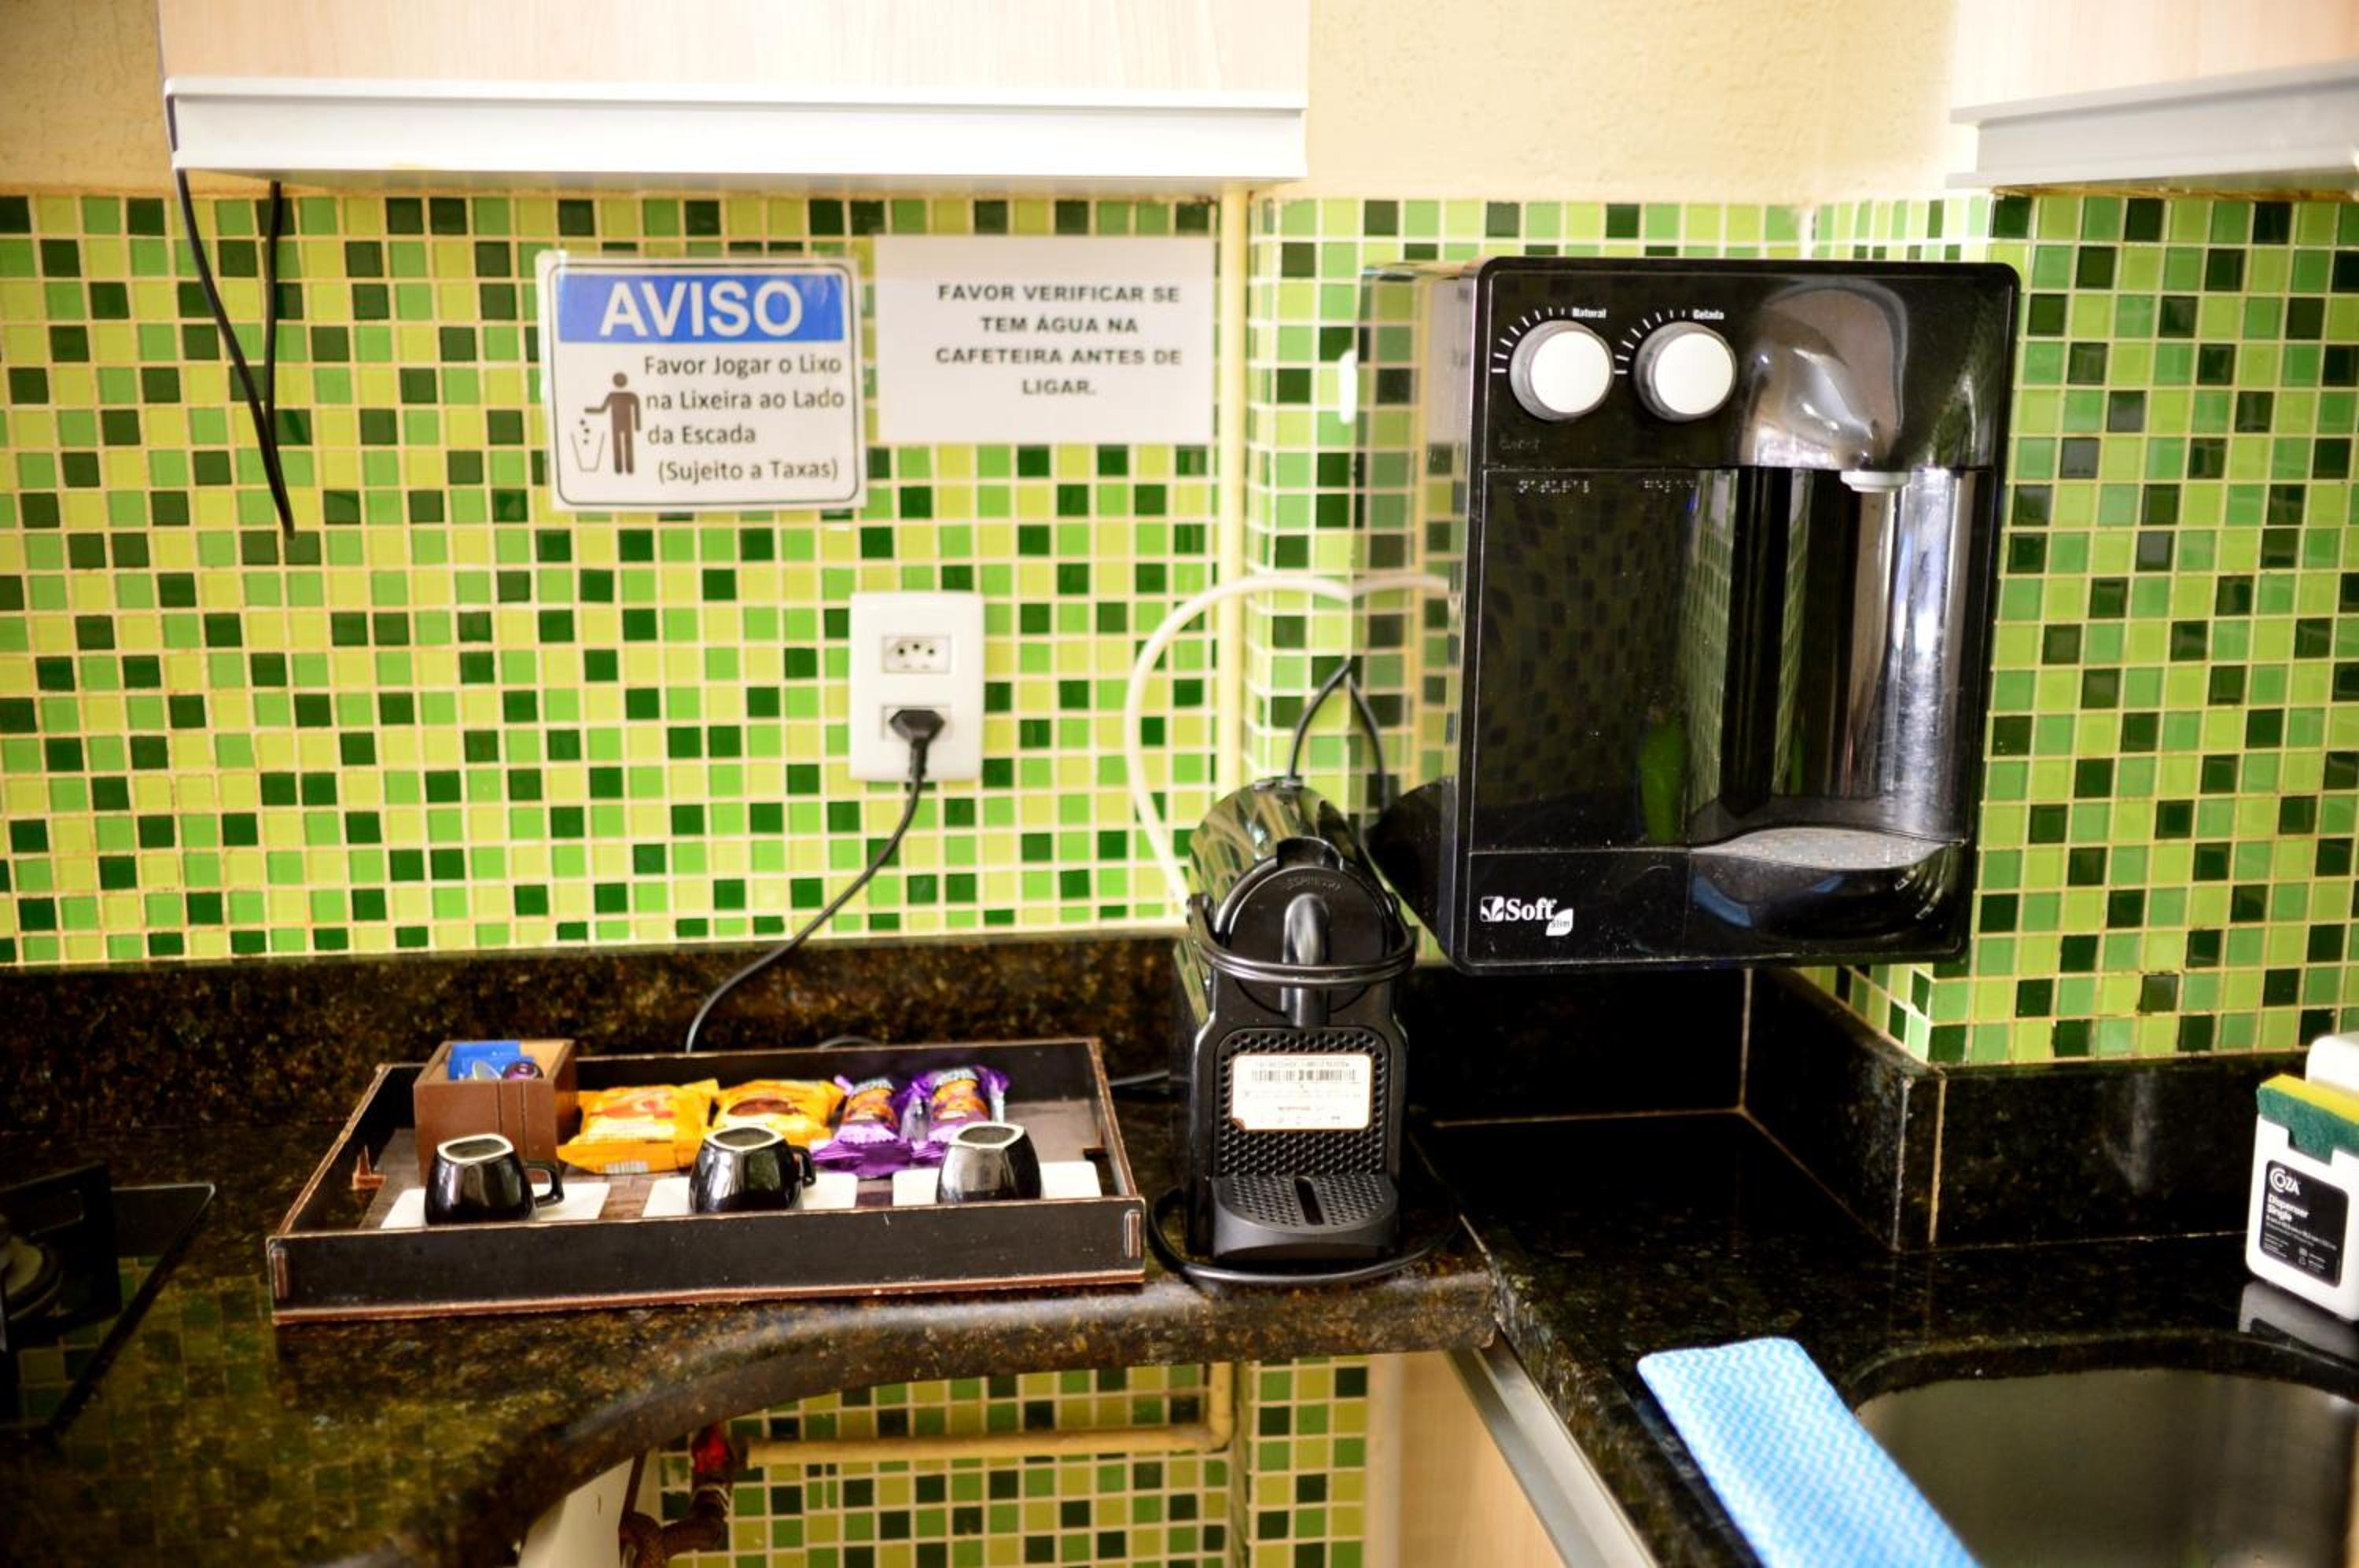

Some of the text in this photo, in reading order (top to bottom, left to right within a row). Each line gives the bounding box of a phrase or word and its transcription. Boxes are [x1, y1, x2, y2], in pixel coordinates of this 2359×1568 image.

[938, 285, 1180, 303] FAVOR VERIFICAR SE
[599, 281, 802, 337] AVISO
[1572, 307, 1606, 318] Natural
[1692, 309, 1724, 320] Gelada
[981, 314, 1139, 333] TEM ÁGUA NA
[644, 354, 842, 380] Favor Jogar o Lixo
[936, 348, 1181, 366] CAFETEIRA ANTES DE
[1022, 379, 1095, 396] LIGAR.
[646, 388, 845, 410] na Lixeira ao Lado
[648, 423, 756, 444] da Escada
[658, 458, 838, 485] (Sujeito a Taxas)
[1506, 897, 1554, 921] Soft
